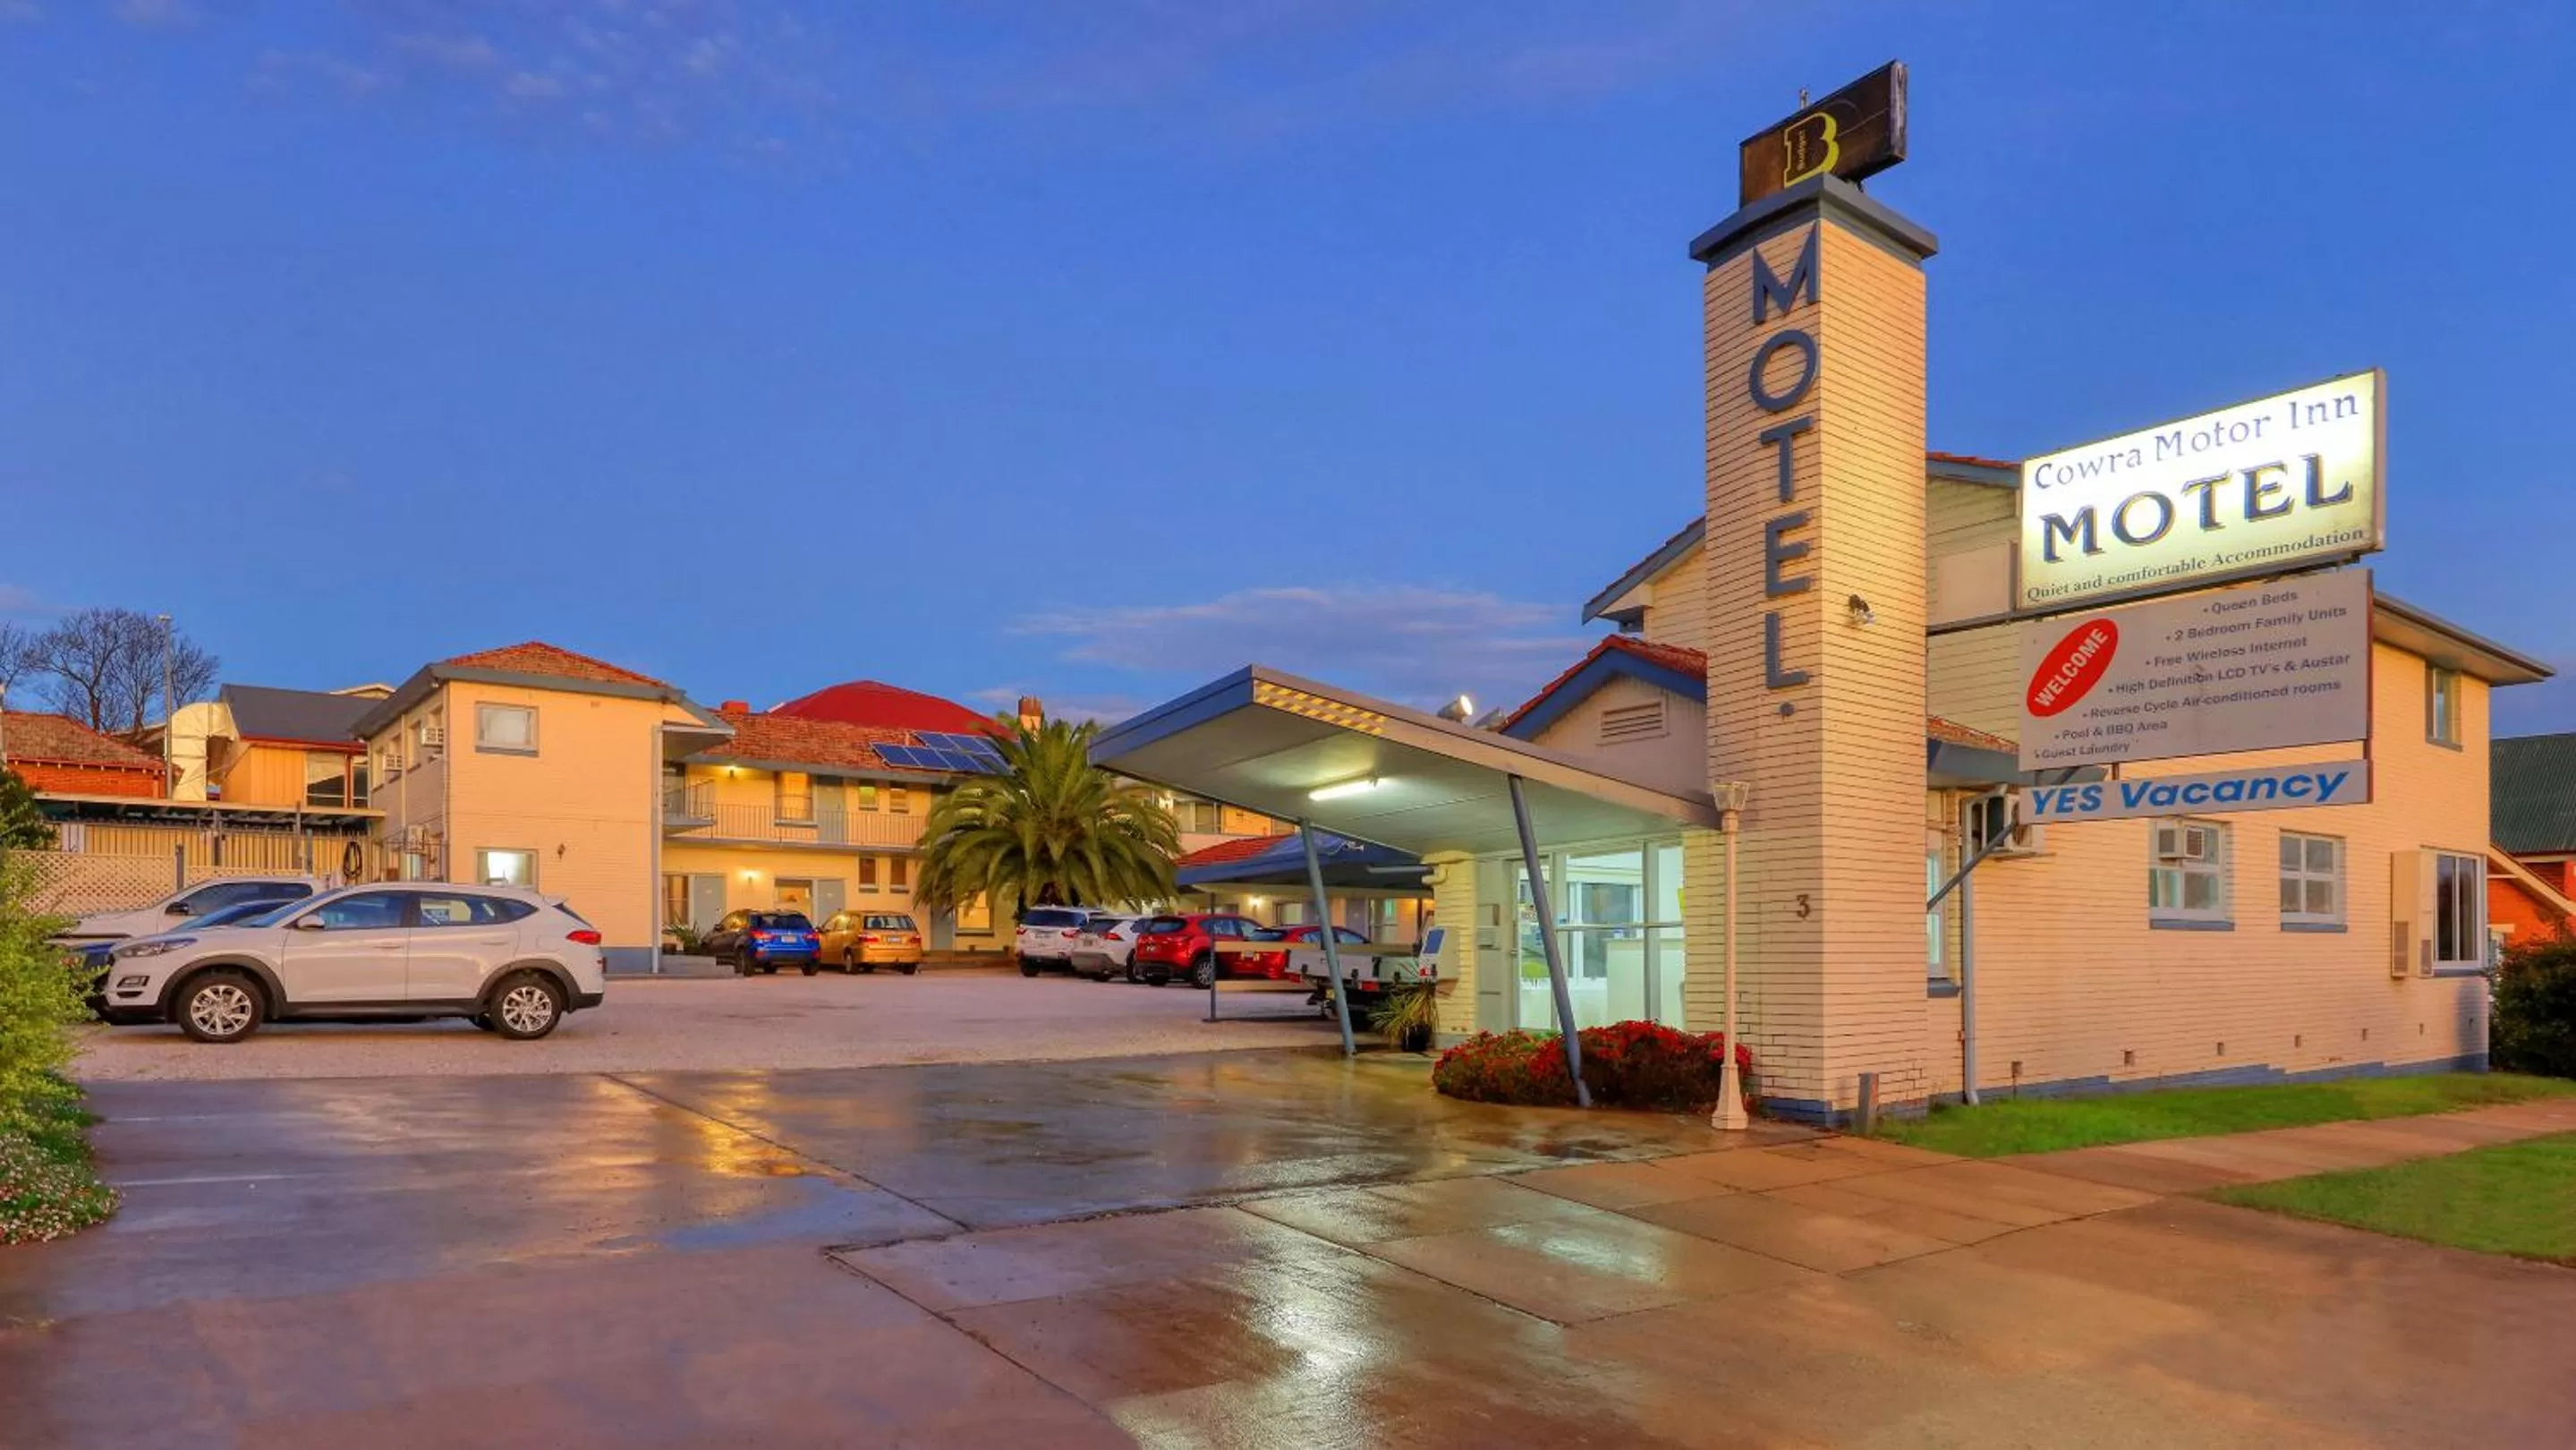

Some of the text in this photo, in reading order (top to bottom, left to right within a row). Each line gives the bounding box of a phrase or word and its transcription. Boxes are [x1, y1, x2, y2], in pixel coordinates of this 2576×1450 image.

[1748, 219, 1821, 688] MOTEL
[2035, 394, 2359, 489] Cowra Motor Inn
[2038, 452, 2354, 564] MOTEL
[2027, 528, 2364, 601] Quiet and comfortable Accommodation
[2211, 591, 2300, 615] Queen Beds
[2173, 606, 2348, 642] 2 Bedroom Family Units
[2032, 627, 2110, 707] WELCOME
[2154, 636, 2309, 668] Free Wireless Internet
[2115, 680, 2146, 695] High
[2148, 671, 2214, 691] Definition
[2217, 667, 2247, 681] LCD
[2283, 660, 2297, 672] &
[2300, 654, 2351, 670] Austar
[2089, 703, 2141, 719] Reverse
[2143, 697, 2179, 714] Cycle
[2292, 679, 2342, 695] rooms
[2041, 740, 2131, 760] Guest Laundry
[2061, 720, 2169, 741] Pool & BBQ Area
[2032, 770, 2351, 816] YES Vacancy
[1796, 894, 1811, 918] 3
